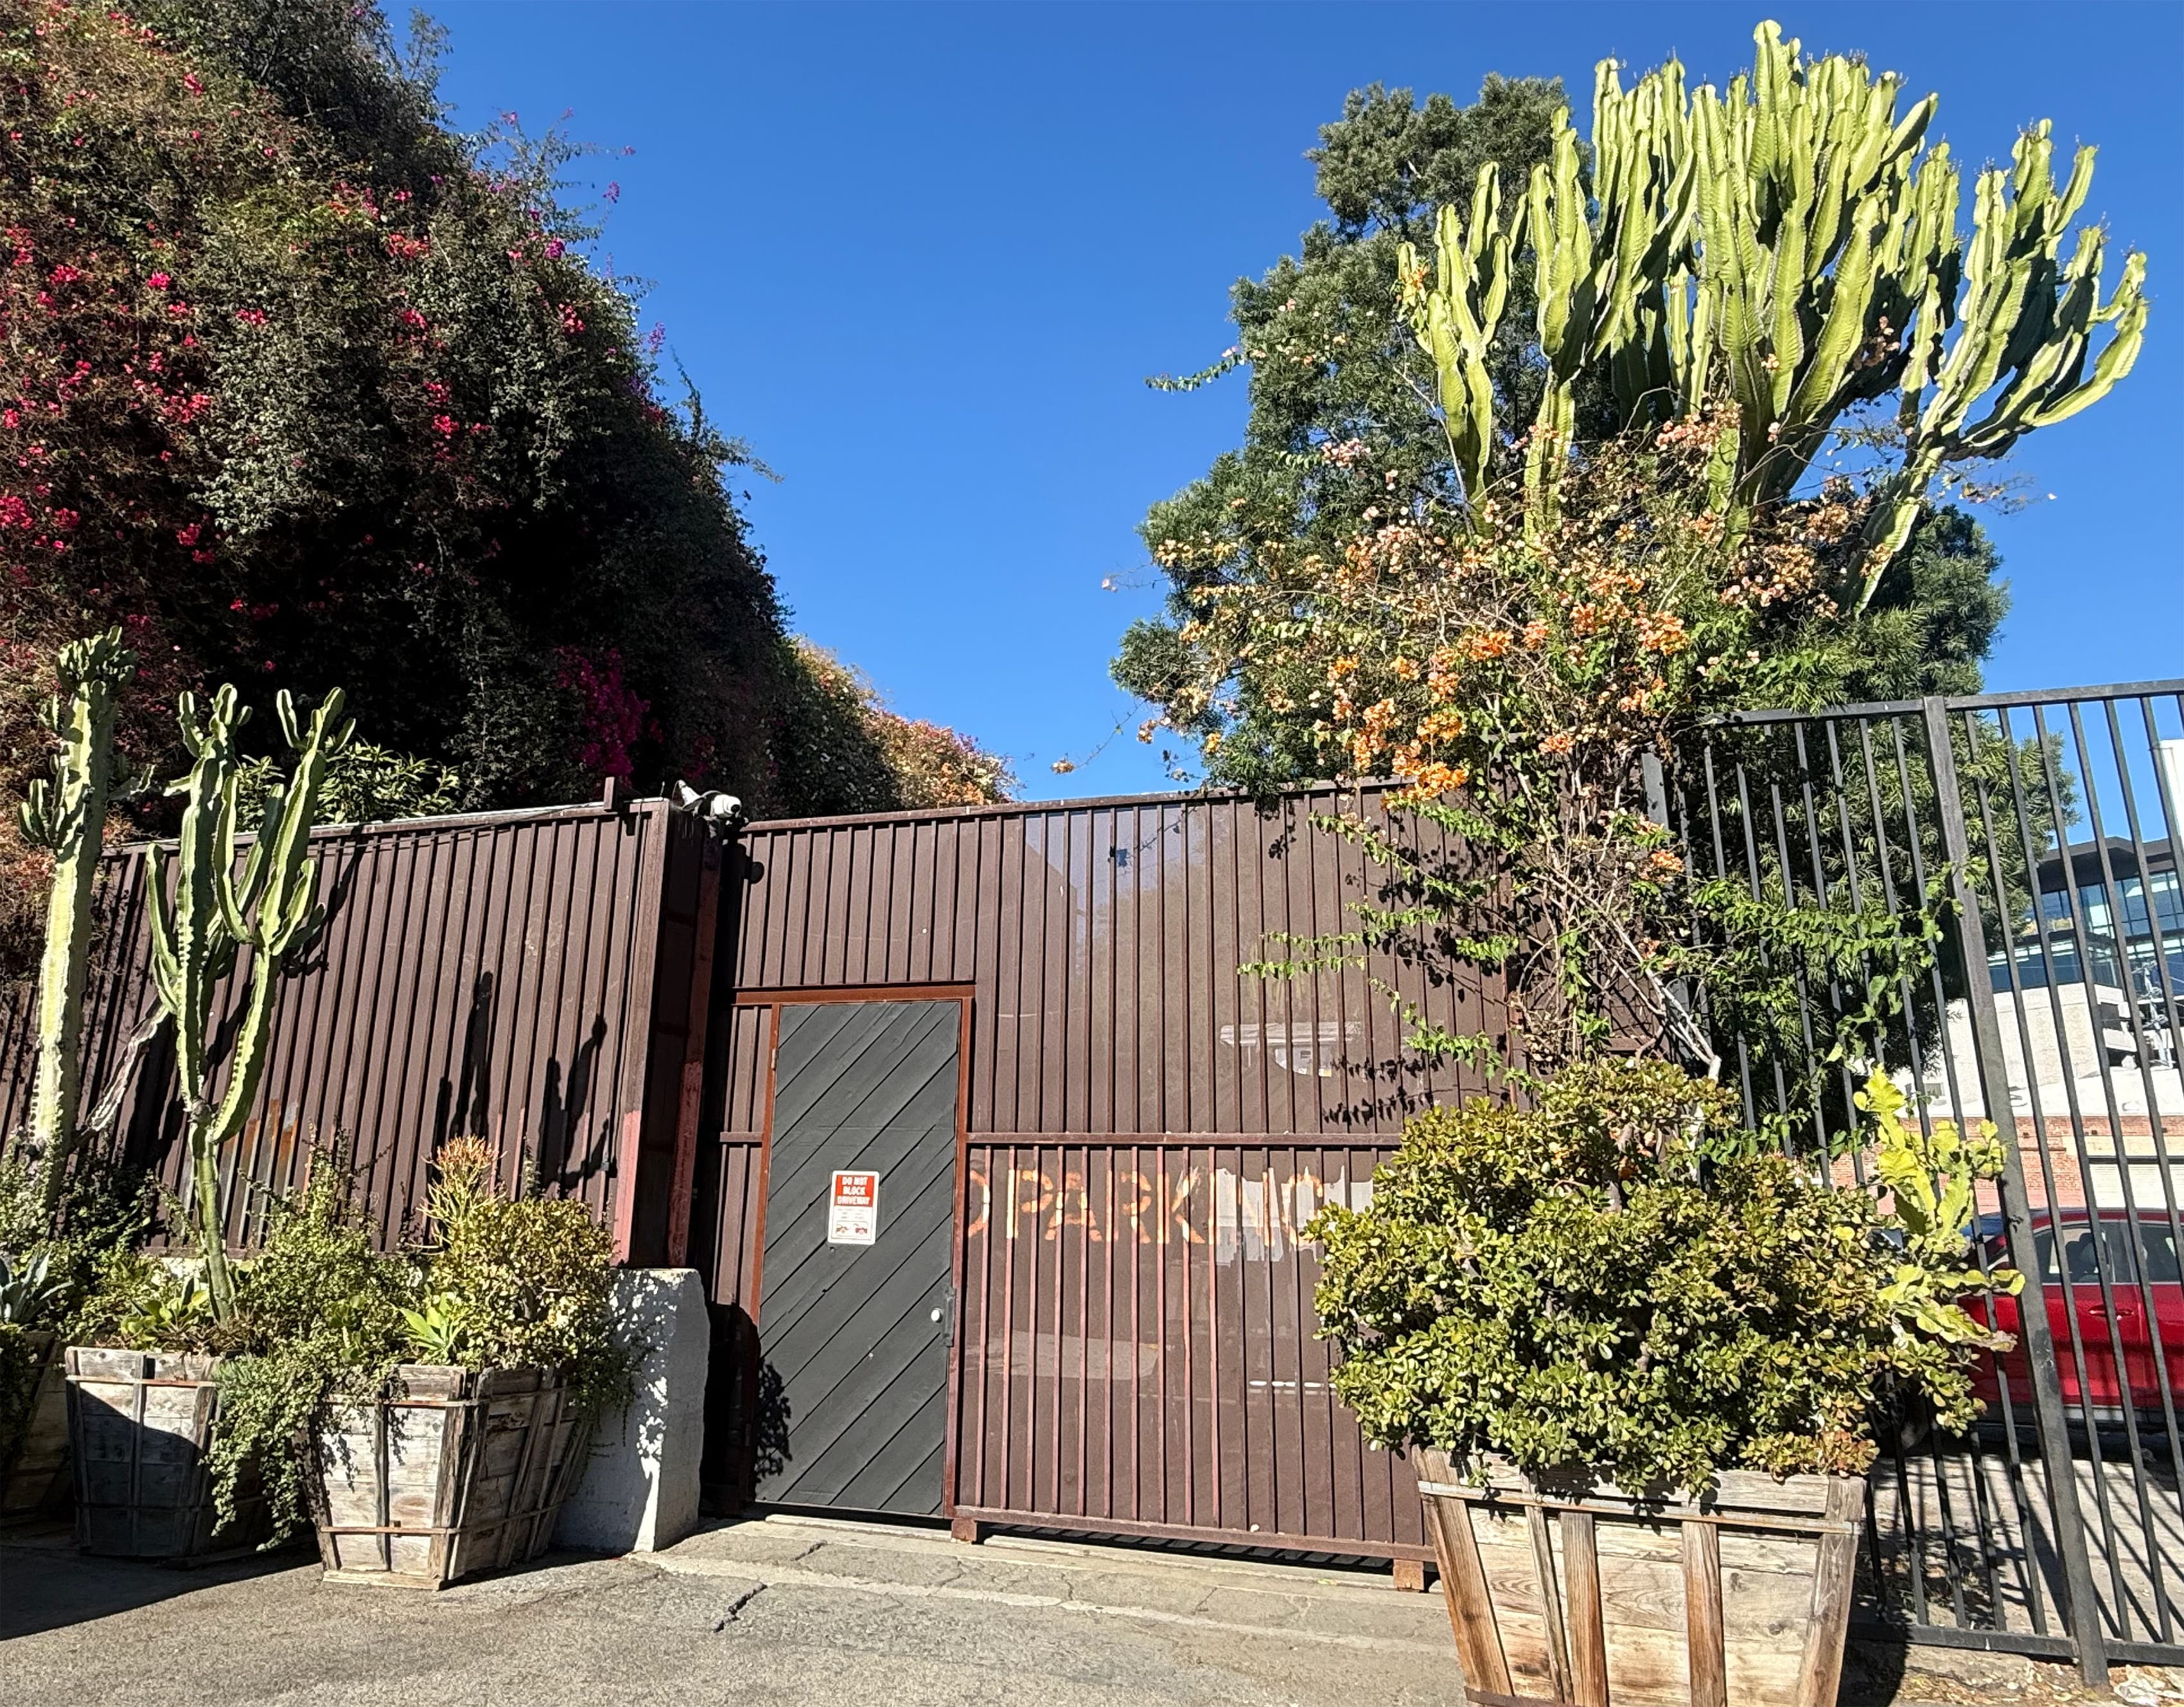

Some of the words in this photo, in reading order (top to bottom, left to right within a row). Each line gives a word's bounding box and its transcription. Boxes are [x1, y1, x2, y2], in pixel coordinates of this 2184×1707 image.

[842, 1176, 852, 1185] DO
[854, 1176, 868, 1185] NOT
[843, 1186, 866, 1195] BLOCK
[1007, 1169, 1325, 1249] PARKING
